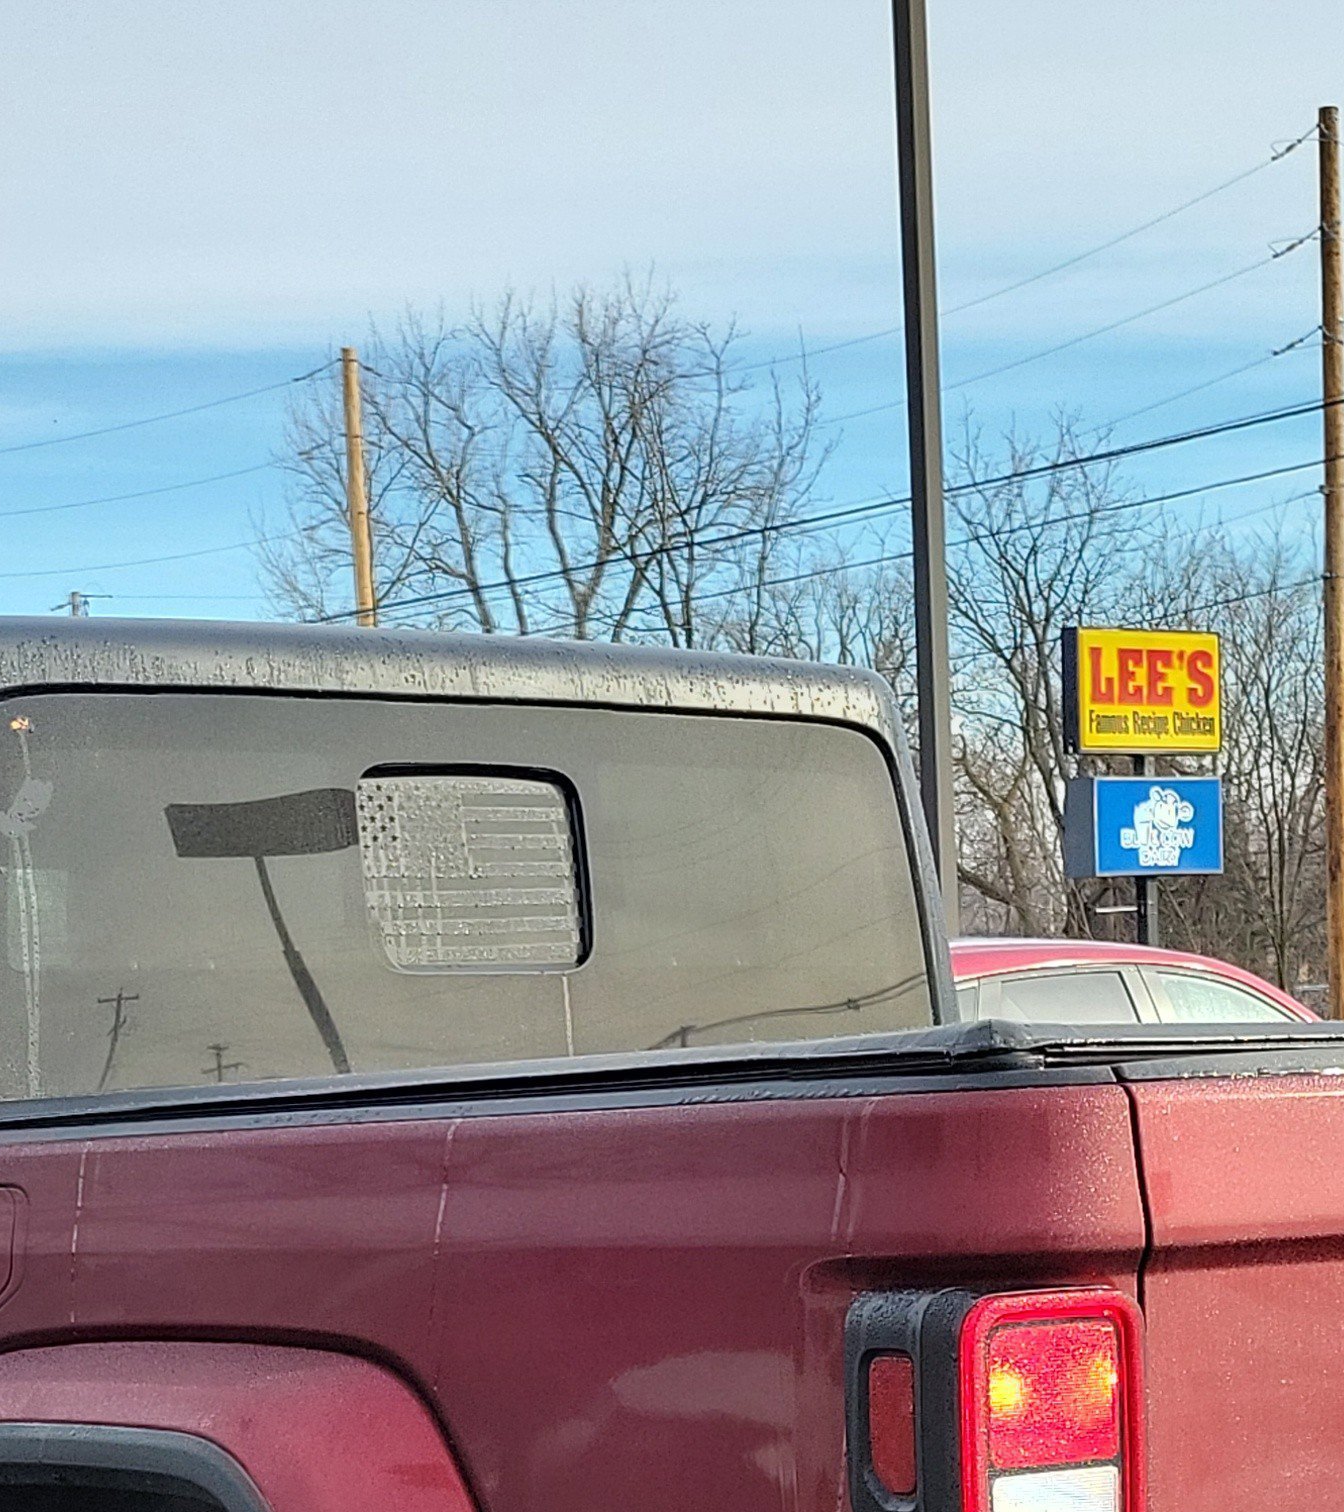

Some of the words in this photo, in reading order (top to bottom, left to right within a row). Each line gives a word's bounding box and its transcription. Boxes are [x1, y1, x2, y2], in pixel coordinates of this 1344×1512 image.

[1089, 646, 1214, 707] LEE'S
[1089, 709, 1129, 734] Famous
[1132, 710, 1169, 739] Recipe
[1173, 711, 1215, 736] Chicken
